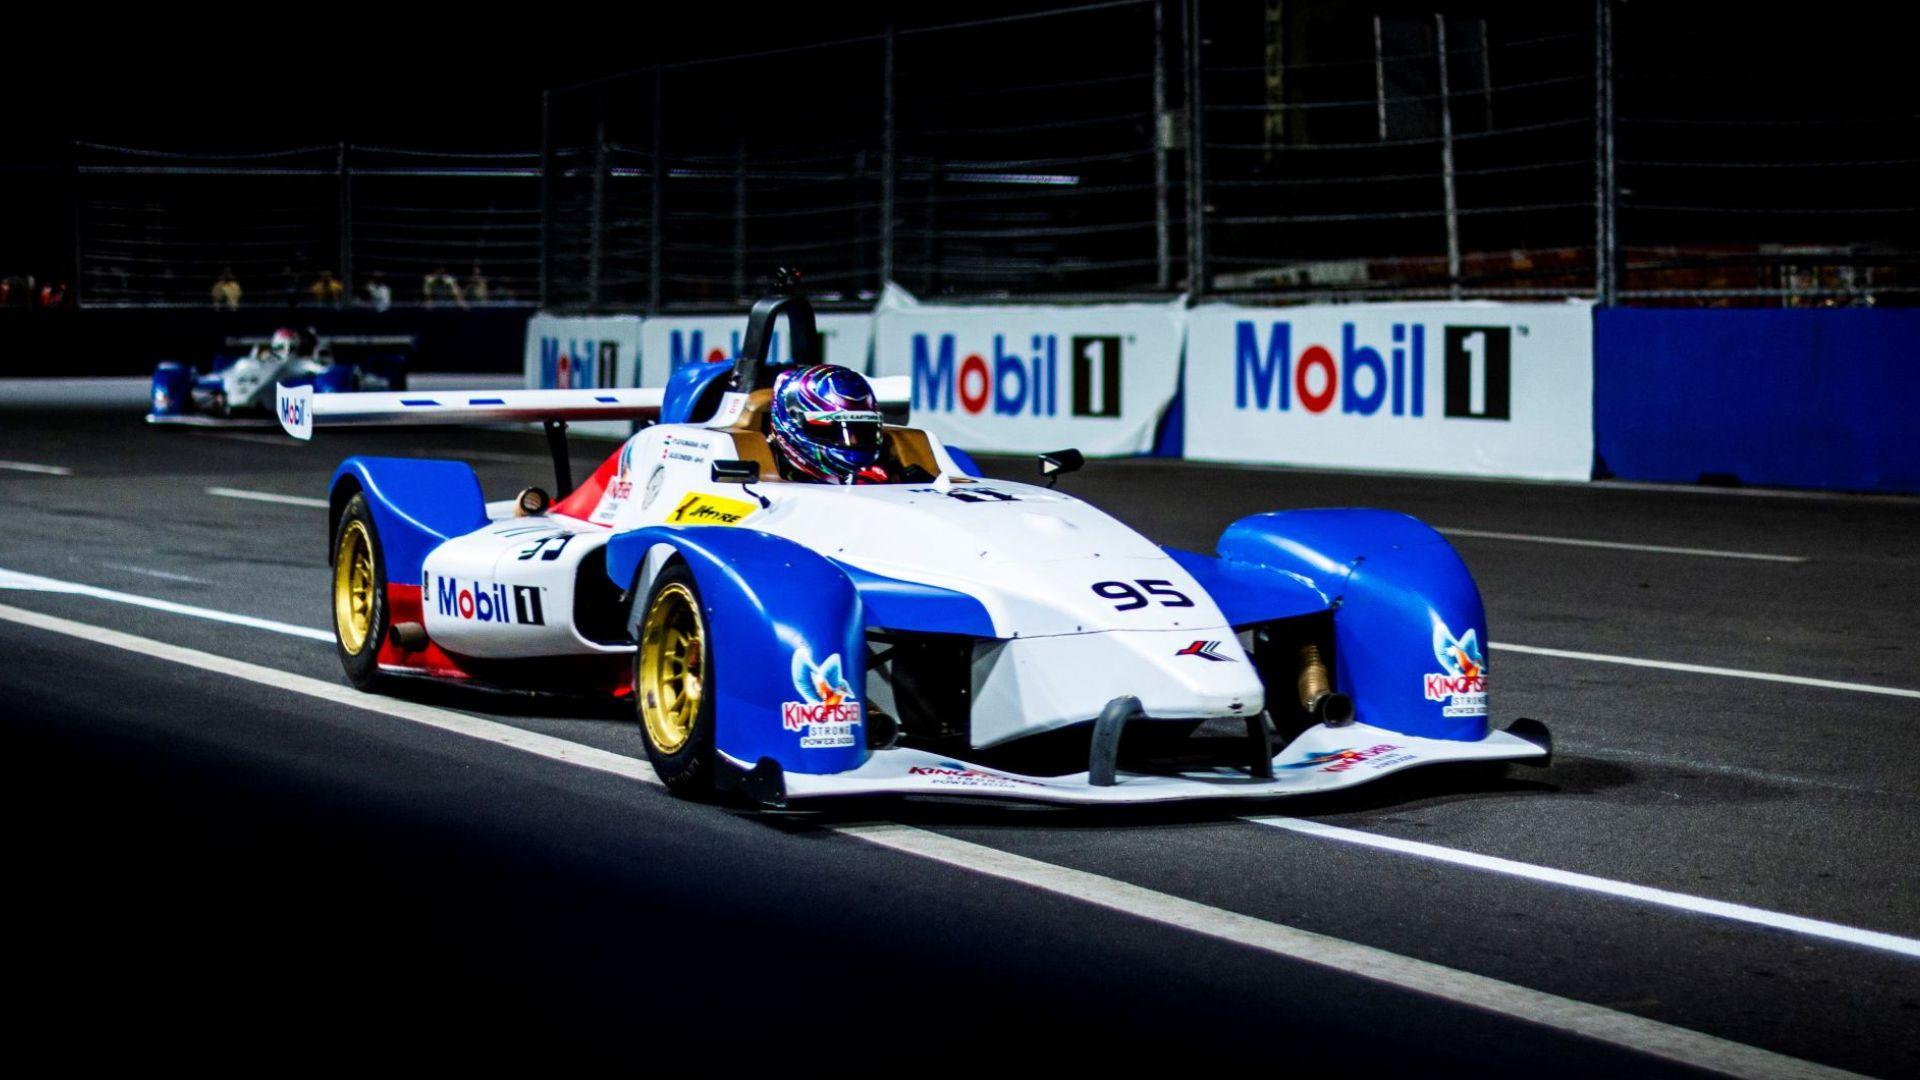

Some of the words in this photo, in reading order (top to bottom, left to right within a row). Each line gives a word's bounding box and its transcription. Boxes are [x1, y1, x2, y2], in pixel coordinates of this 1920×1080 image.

[911, 332, 1057, 417] Mobil
[1235, 321, 1425, 418] Mobil
[437, 576, 510, 624] Mobil
[1091, 579, 1195, 611] 95
